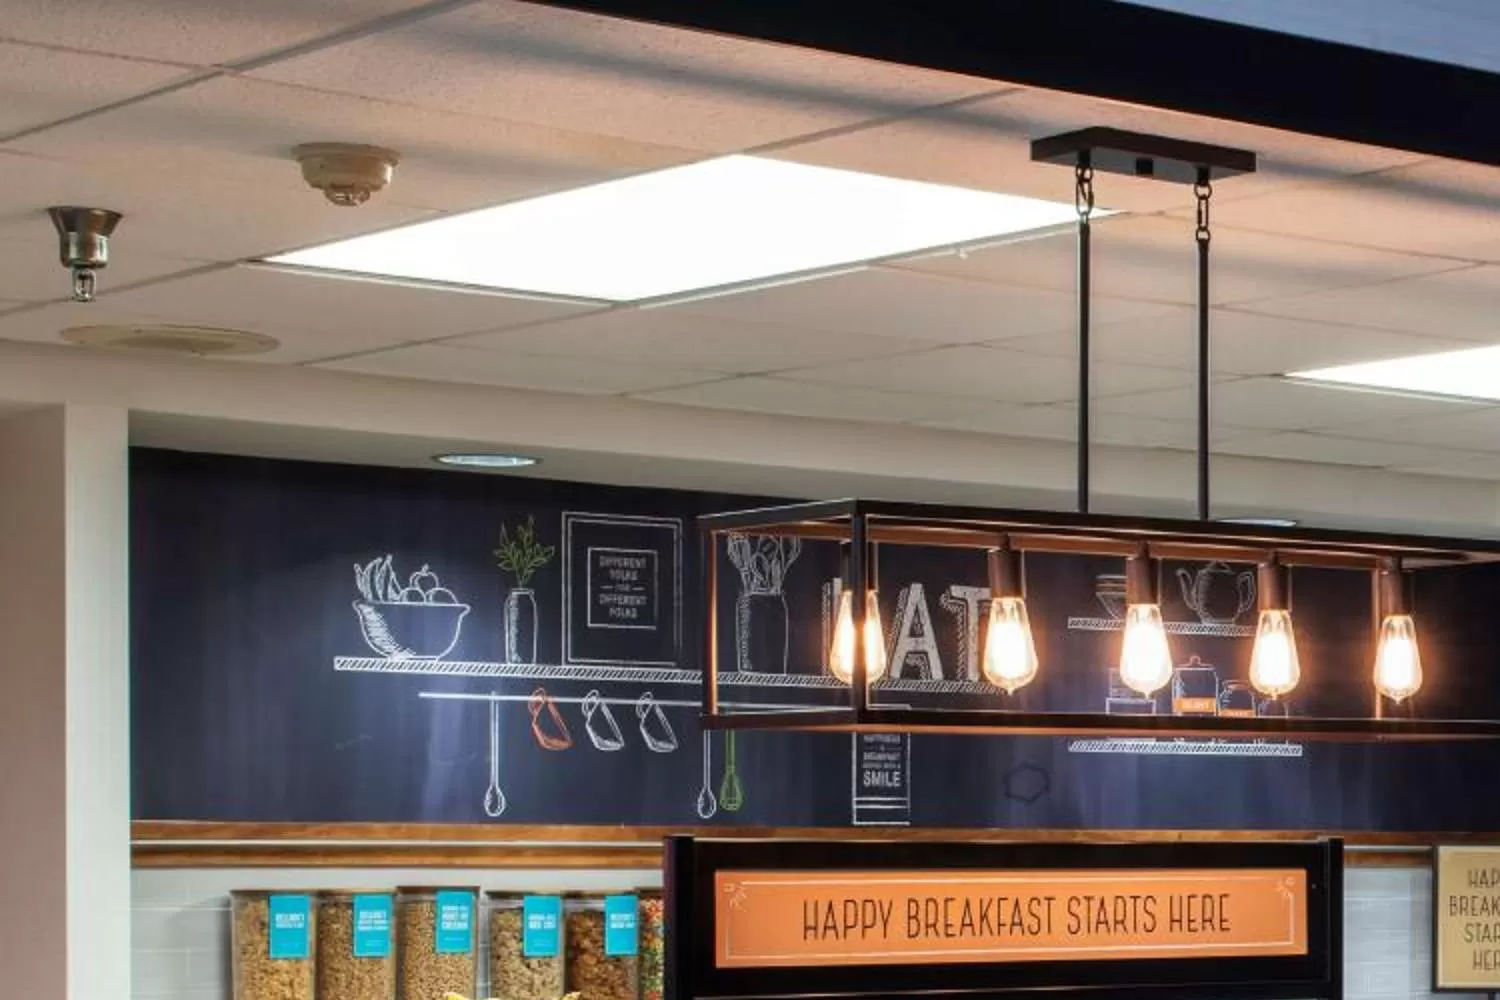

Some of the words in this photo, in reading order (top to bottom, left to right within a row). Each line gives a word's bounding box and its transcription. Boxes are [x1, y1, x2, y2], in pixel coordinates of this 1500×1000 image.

[863, 771, 901, 787] SMILE
[802, 898, 893, 941] HAPPY
[906, 896, 1056, 939] BREAKFAST
[1067, 895, 1157, 936] STARTS
[1168, 893, 1232, 933] HERE
